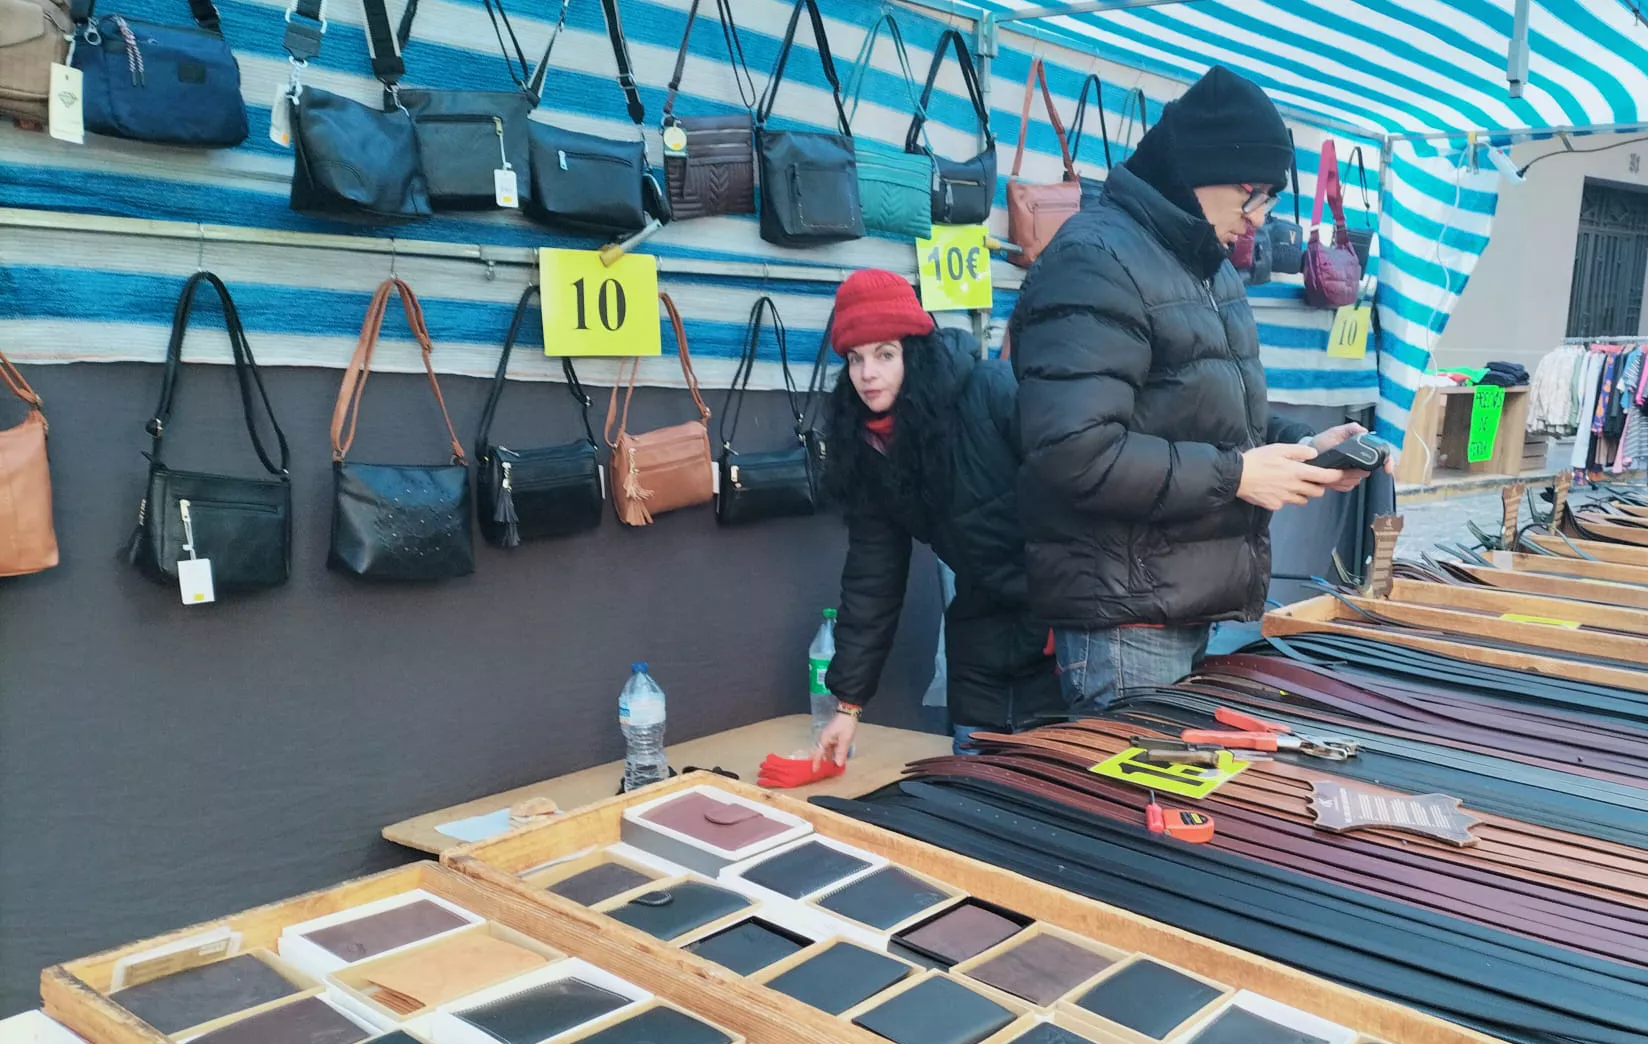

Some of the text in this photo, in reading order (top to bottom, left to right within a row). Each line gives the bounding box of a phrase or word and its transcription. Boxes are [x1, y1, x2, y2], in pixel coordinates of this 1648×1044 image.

[928, 246, 981, 281] 10€
[570, 276, 627, 332] 10
[1337, 319, 1358, 346] 10
